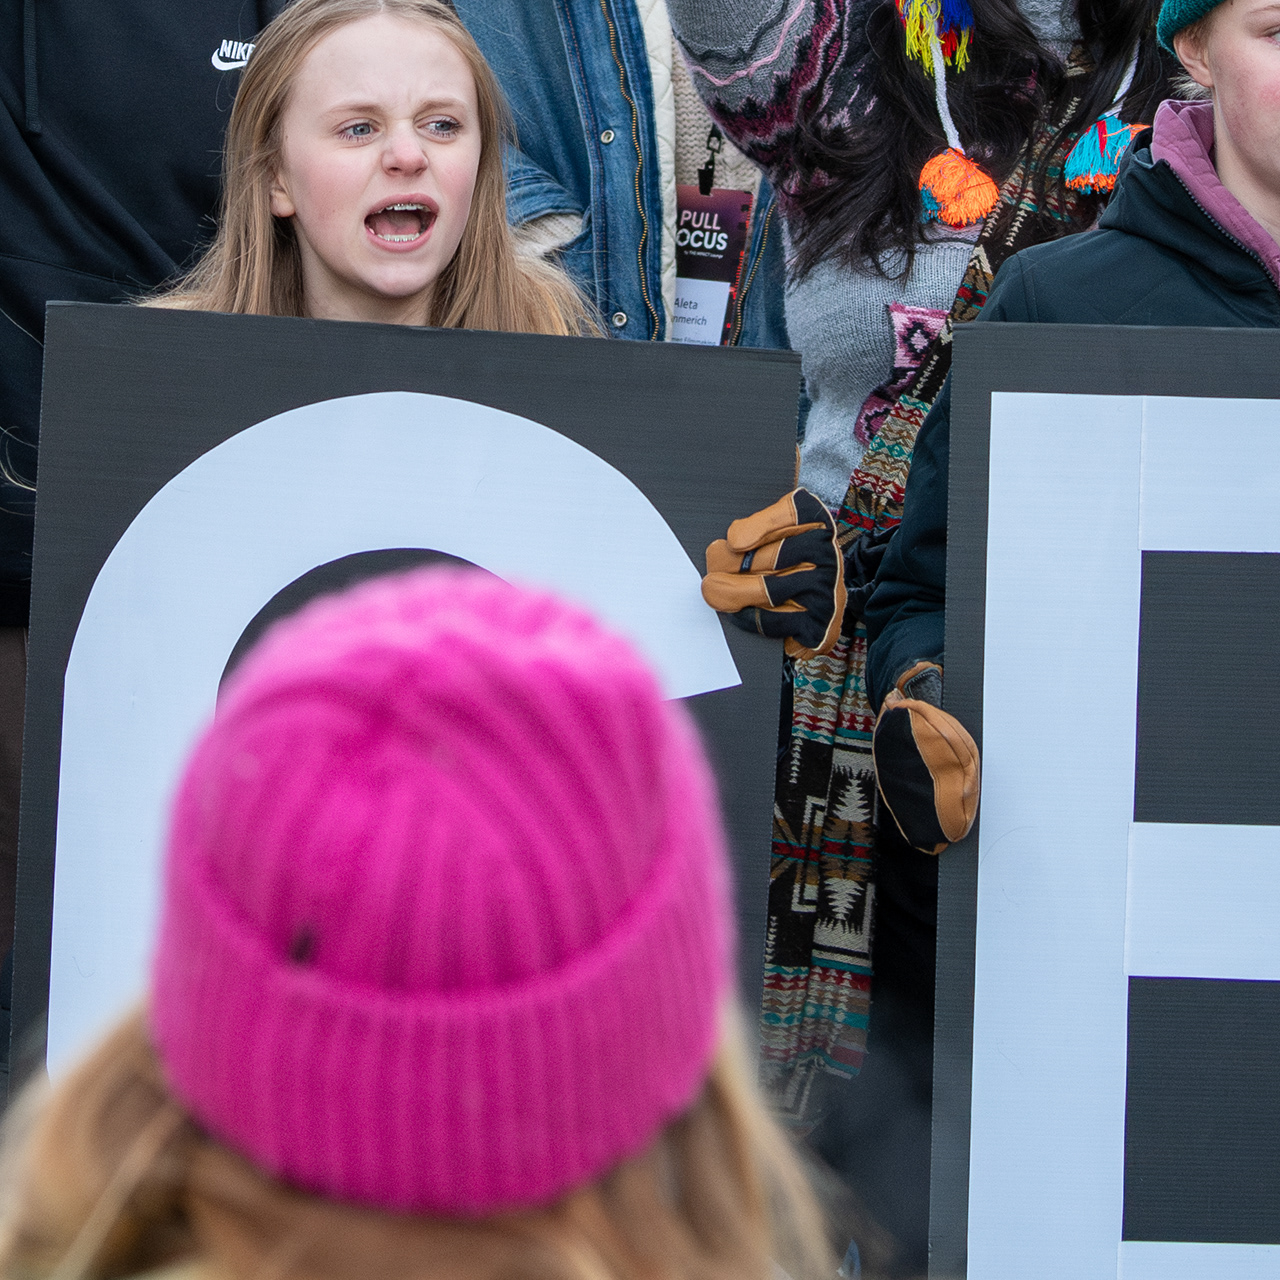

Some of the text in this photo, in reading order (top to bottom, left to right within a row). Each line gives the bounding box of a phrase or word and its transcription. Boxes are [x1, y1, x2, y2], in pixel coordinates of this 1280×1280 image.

[679, 209, 722, 231] PULL
[676, 228, 729, 251] OCUS
[674, 298, 698, 310] Aleta
